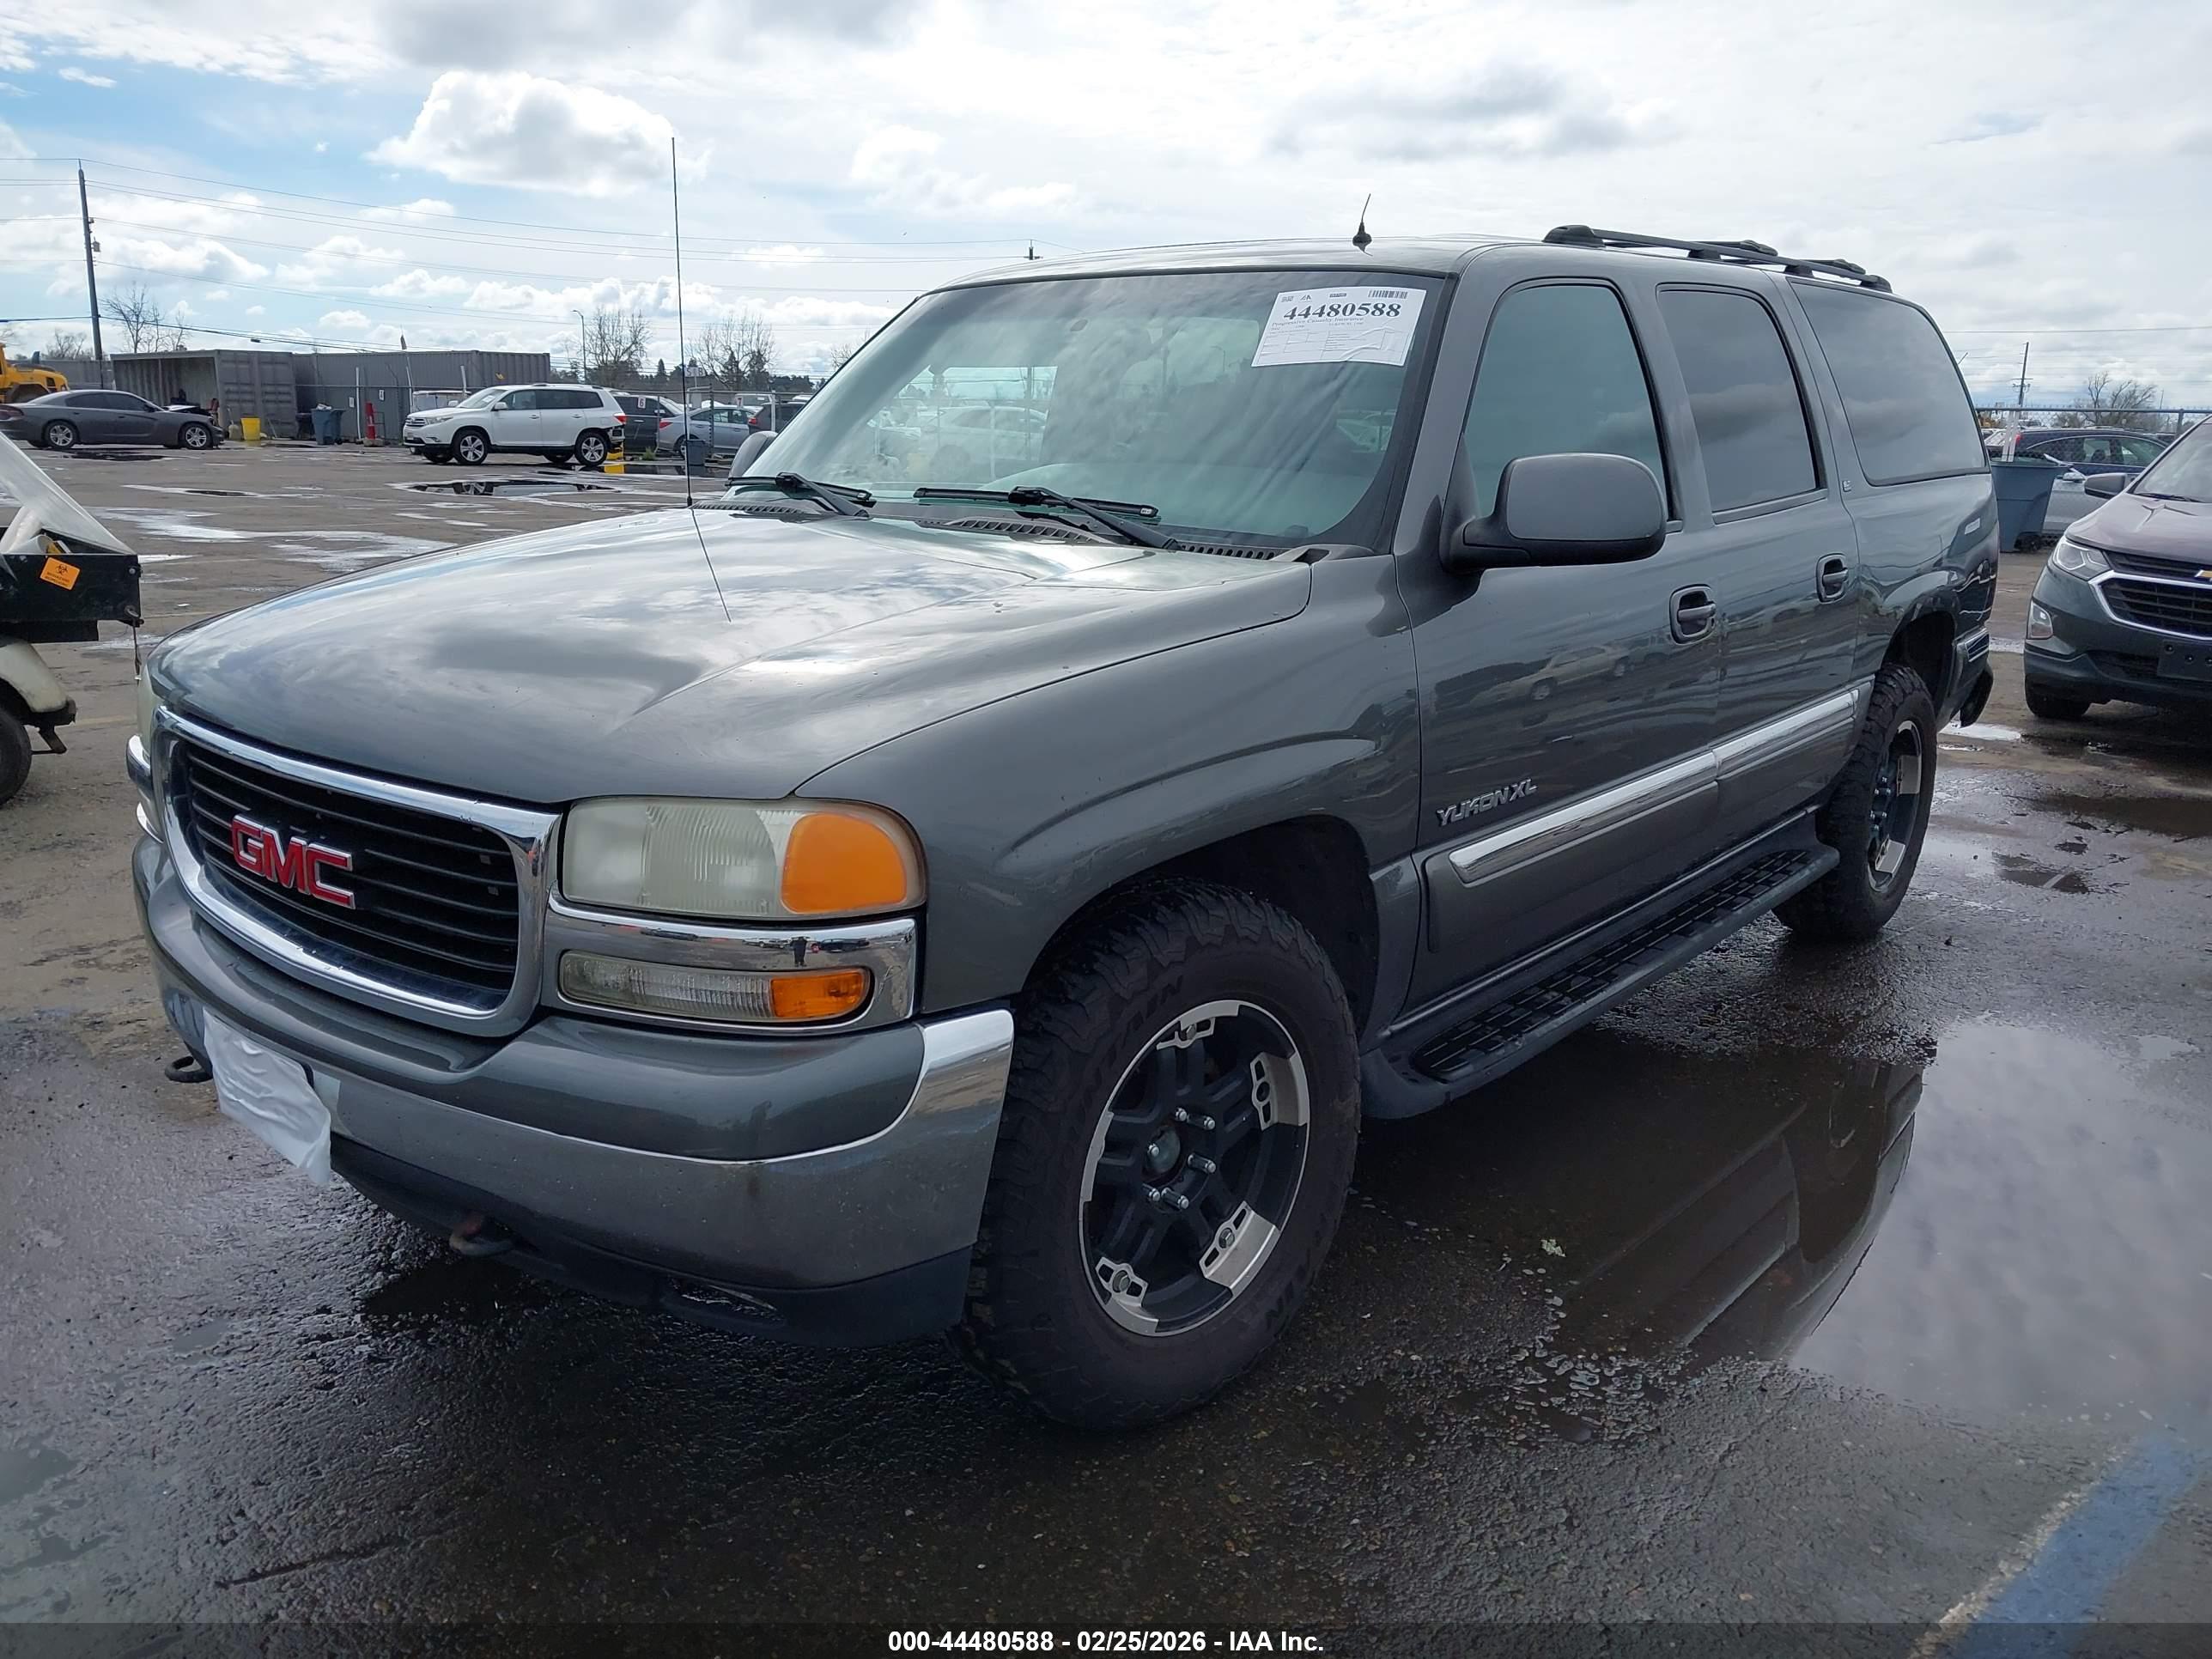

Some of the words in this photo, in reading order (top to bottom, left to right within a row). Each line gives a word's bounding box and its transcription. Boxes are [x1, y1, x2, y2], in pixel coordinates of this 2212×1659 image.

[1283, 303, 1401, 320] 44480588
[1437, 788, 1510, 826] YUKON
[1509, 778, 1539, 802] XL
[231, 815, 356, 909] GMC
